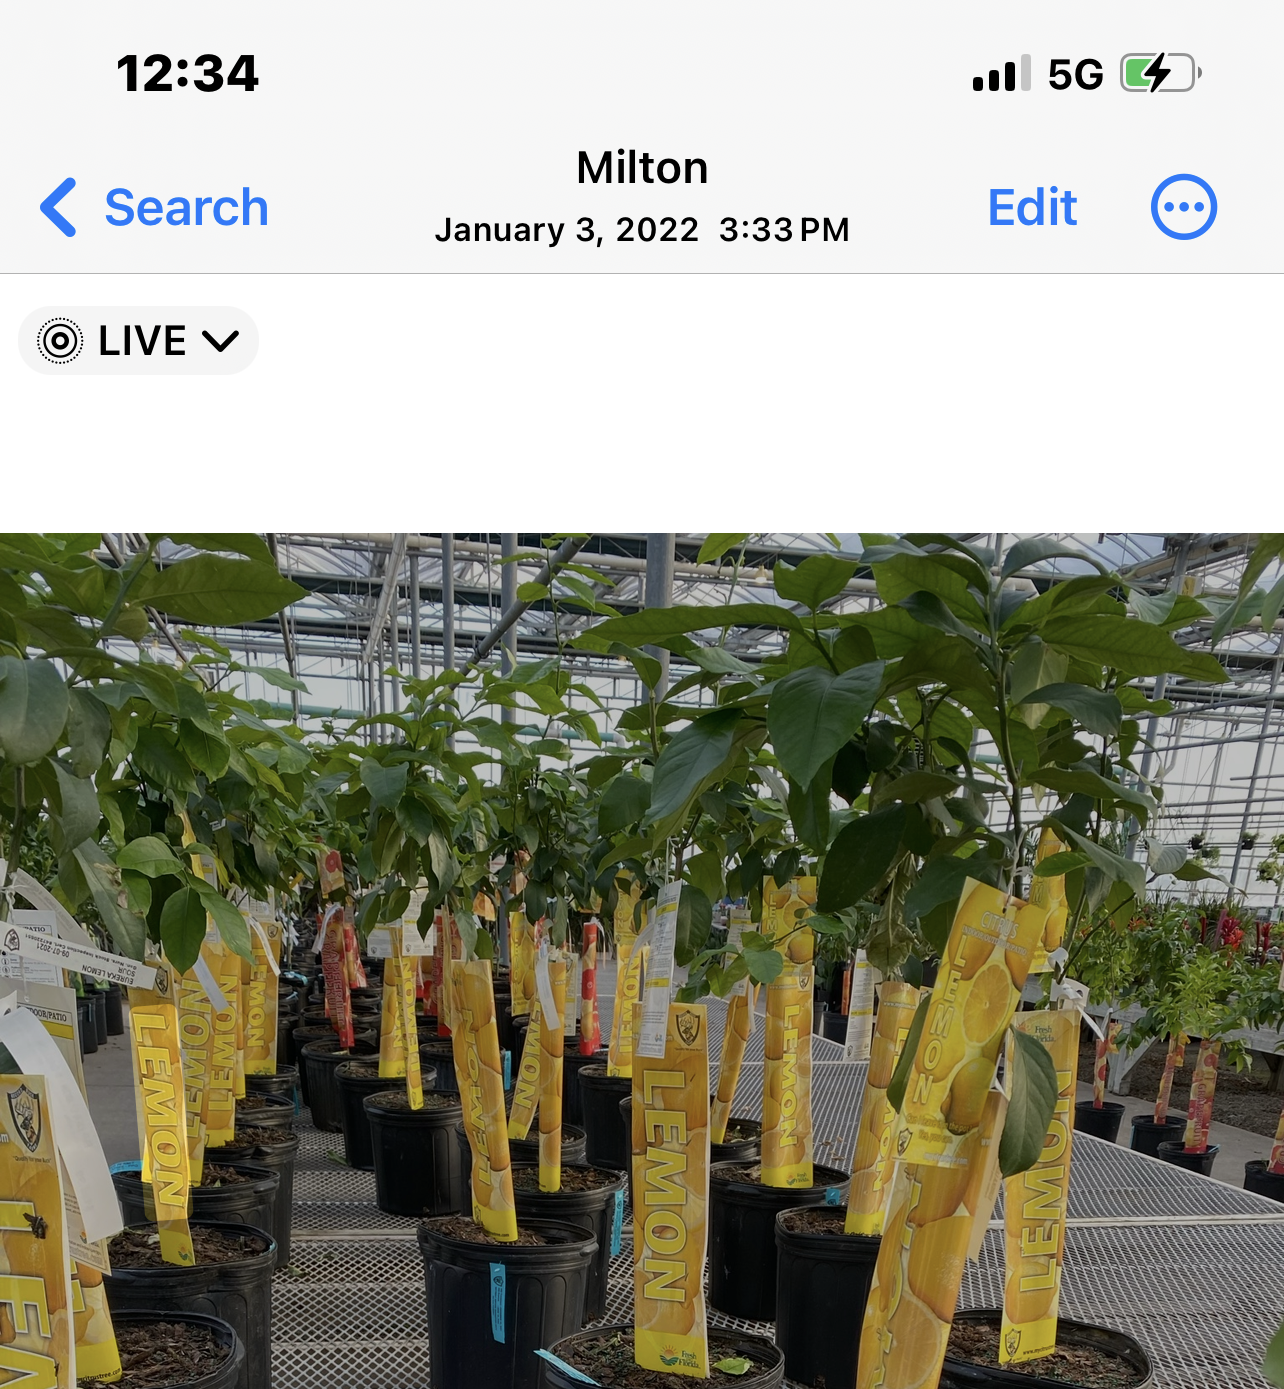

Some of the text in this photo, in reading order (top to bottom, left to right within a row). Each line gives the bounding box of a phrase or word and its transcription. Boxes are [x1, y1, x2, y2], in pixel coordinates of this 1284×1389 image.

[117, 53, 260, 93] 12:34
[1048, 57, 1104, 91] 5G
[578, 147, 708, 185] Milton
[105, 186, 268, 227] Search
[989, 185, 1078, 227] Edit
[434, 216, 849, 249] January 3, 2022 3:33 PM
[99, 324, 186, 356] LIVE
[980, 911, 1019, 940] CITRUS
[82, 963, 135, 986] EUREKA LEMON
[117, 966, 136, 978] SOUR
[912, 933, 969, 1105] LEMON
[208, 975, 238, 1112] LEMON
[780, 1004, 801, 1148] LEMON
[131, 1012, 186, 1209] LEMON
[461, 1008, 492, 1187] LEMON
[643, 1069, 687, 1303] LEMON
[678, 1358, 701, 1370] Florida
[681, 1349, 697, 1361] Fresh
